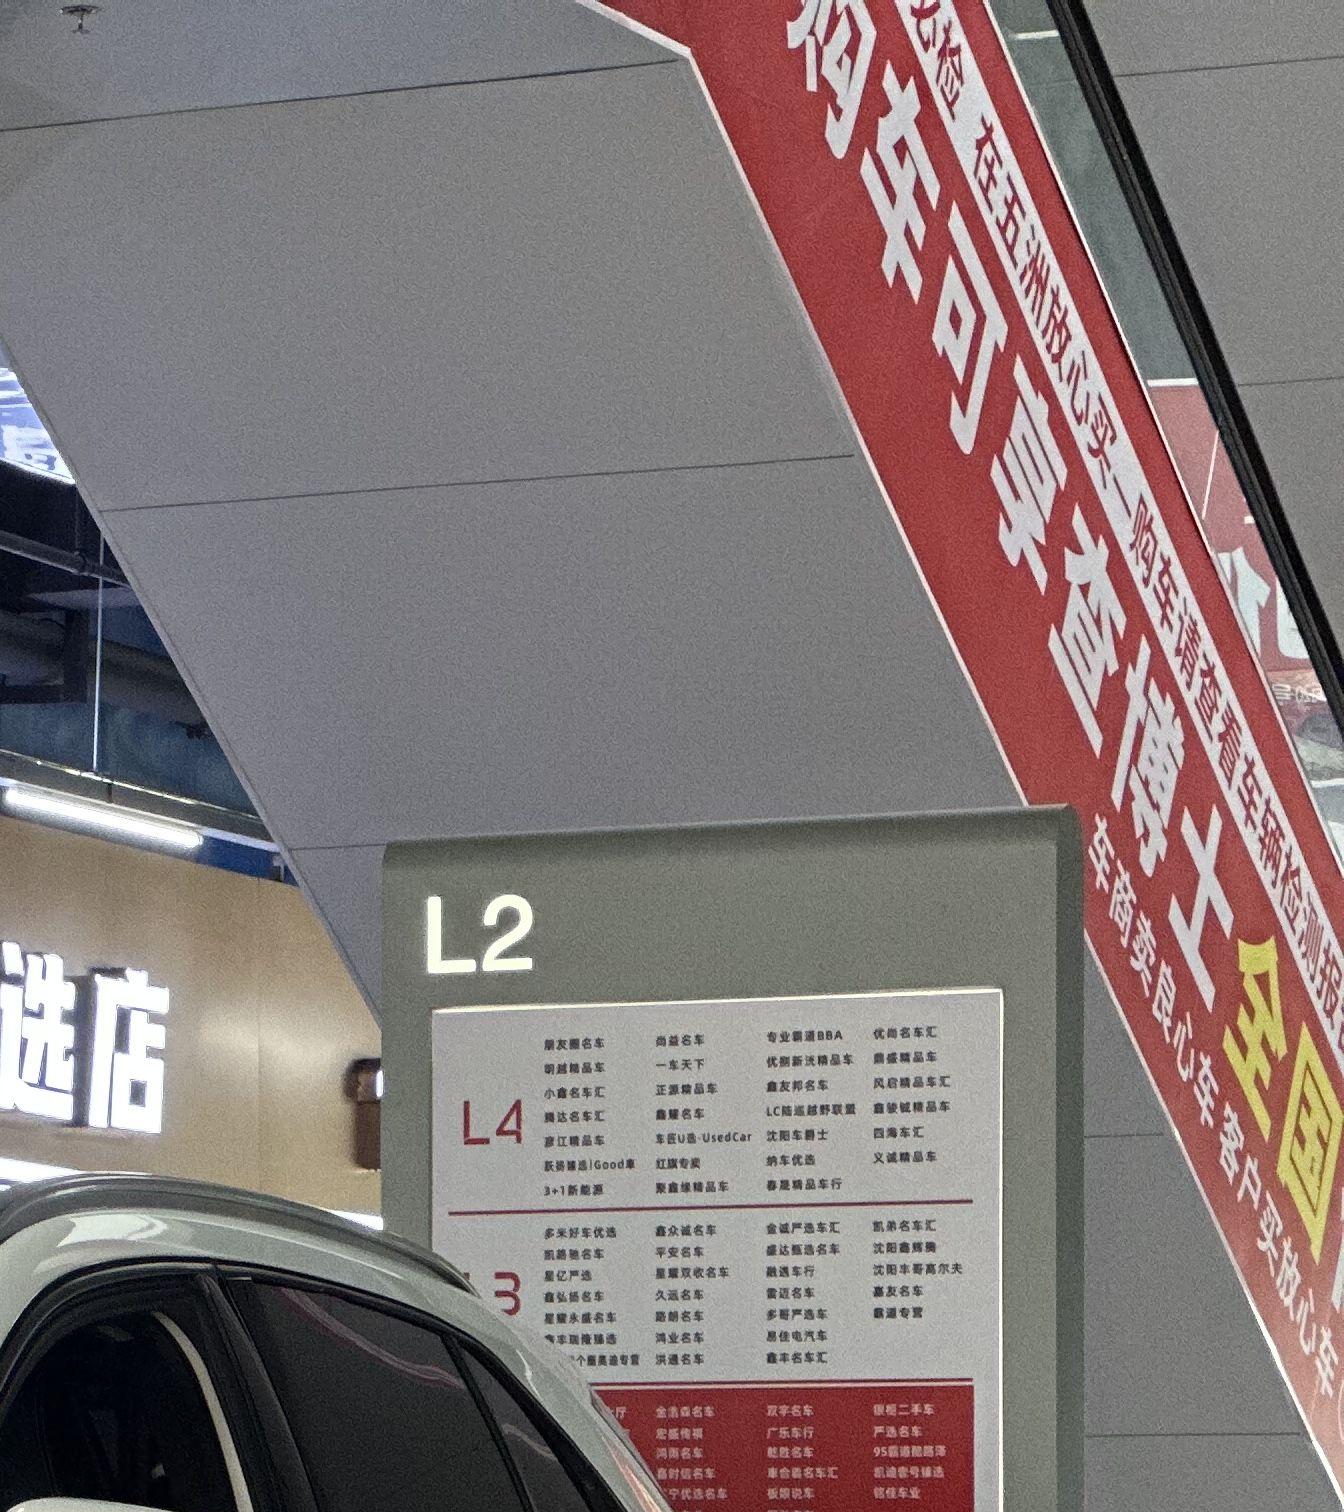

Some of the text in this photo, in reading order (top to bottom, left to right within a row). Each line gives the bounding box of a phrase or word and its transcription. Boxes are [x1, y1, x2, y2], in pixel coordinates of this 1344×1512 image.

[425, 895, 534, 974] L2
[656, 1058, 705, 1071] 一车天下
[462, 1099, 522, 1146] L4
